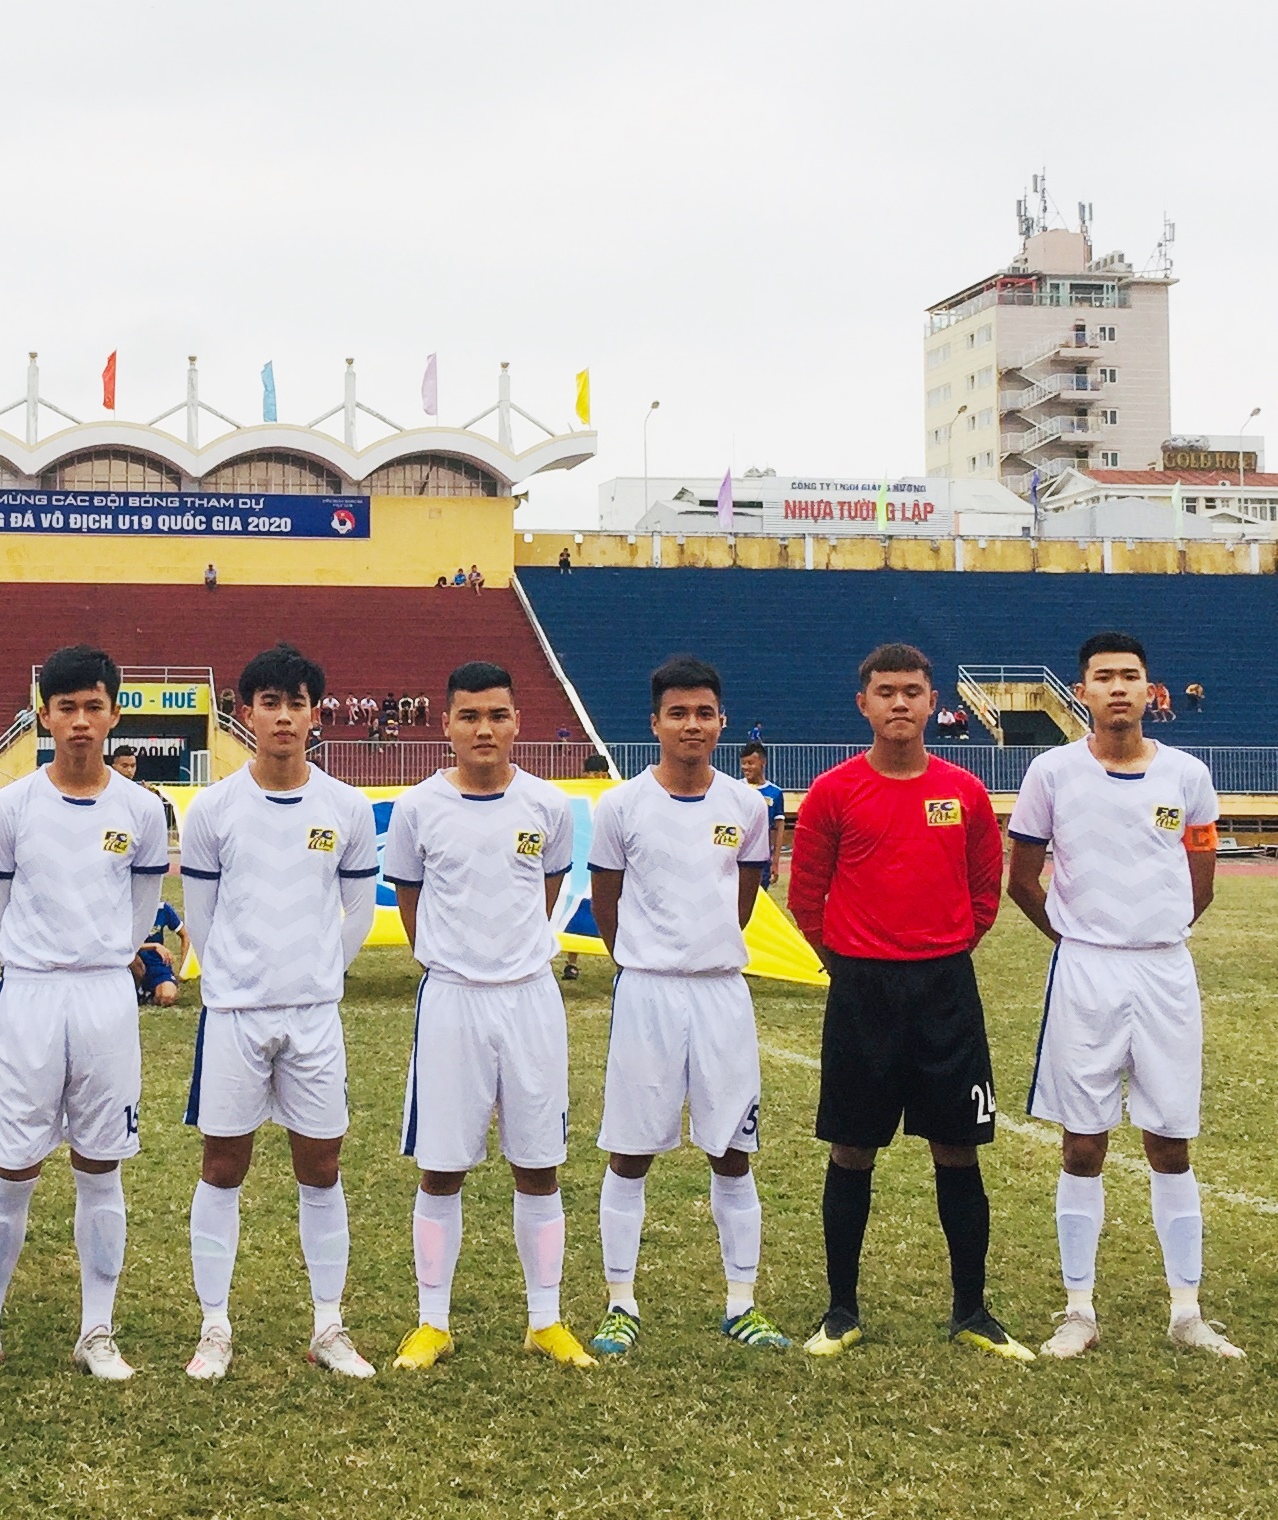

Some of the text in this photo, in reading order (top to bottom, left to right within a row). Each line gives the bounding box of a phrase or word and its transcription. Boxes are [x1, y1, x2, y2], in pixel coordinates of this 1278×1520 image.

[1163, 451, 1256, 469] GOLD Hoel
[819, 482, 831, 491] TY
[52, 492, 91, 506] CÁC
[93, 493, 124, 510] ĐỘI
[128, 495, 179, 508] BÓNG
[183, 497, 235, 509] THAM
[239, 497, 265, 511] DỰ
[784, 499, 834, 523] NHỰA
[901, 499, 935, 525] LẬP
[9, 510, 35, 528] ĐÁ
[40, 510, 65, 528] VÔ
[69, 513, 113, 532] ĐỊCH
[118, 514, 153, 530] U19
[158, 510, 207, 531] QUỐC
[212, 517, 243, 531] GIA
[247, 517, 292, 532] 2020
[162, 686, 198, 709] HUẾ
[928, 801, 954, 812] FC
[1155, 806, 1179, 818] FC
[105, 831, 127, 843] FC
[310, 829, 334, 840] FC
[518, 832, 540, 843] FC
[713, 825, 737, 835] FC
[1193, 827, 1210, 846] C
[741, 1104, 759, 1135] 5
